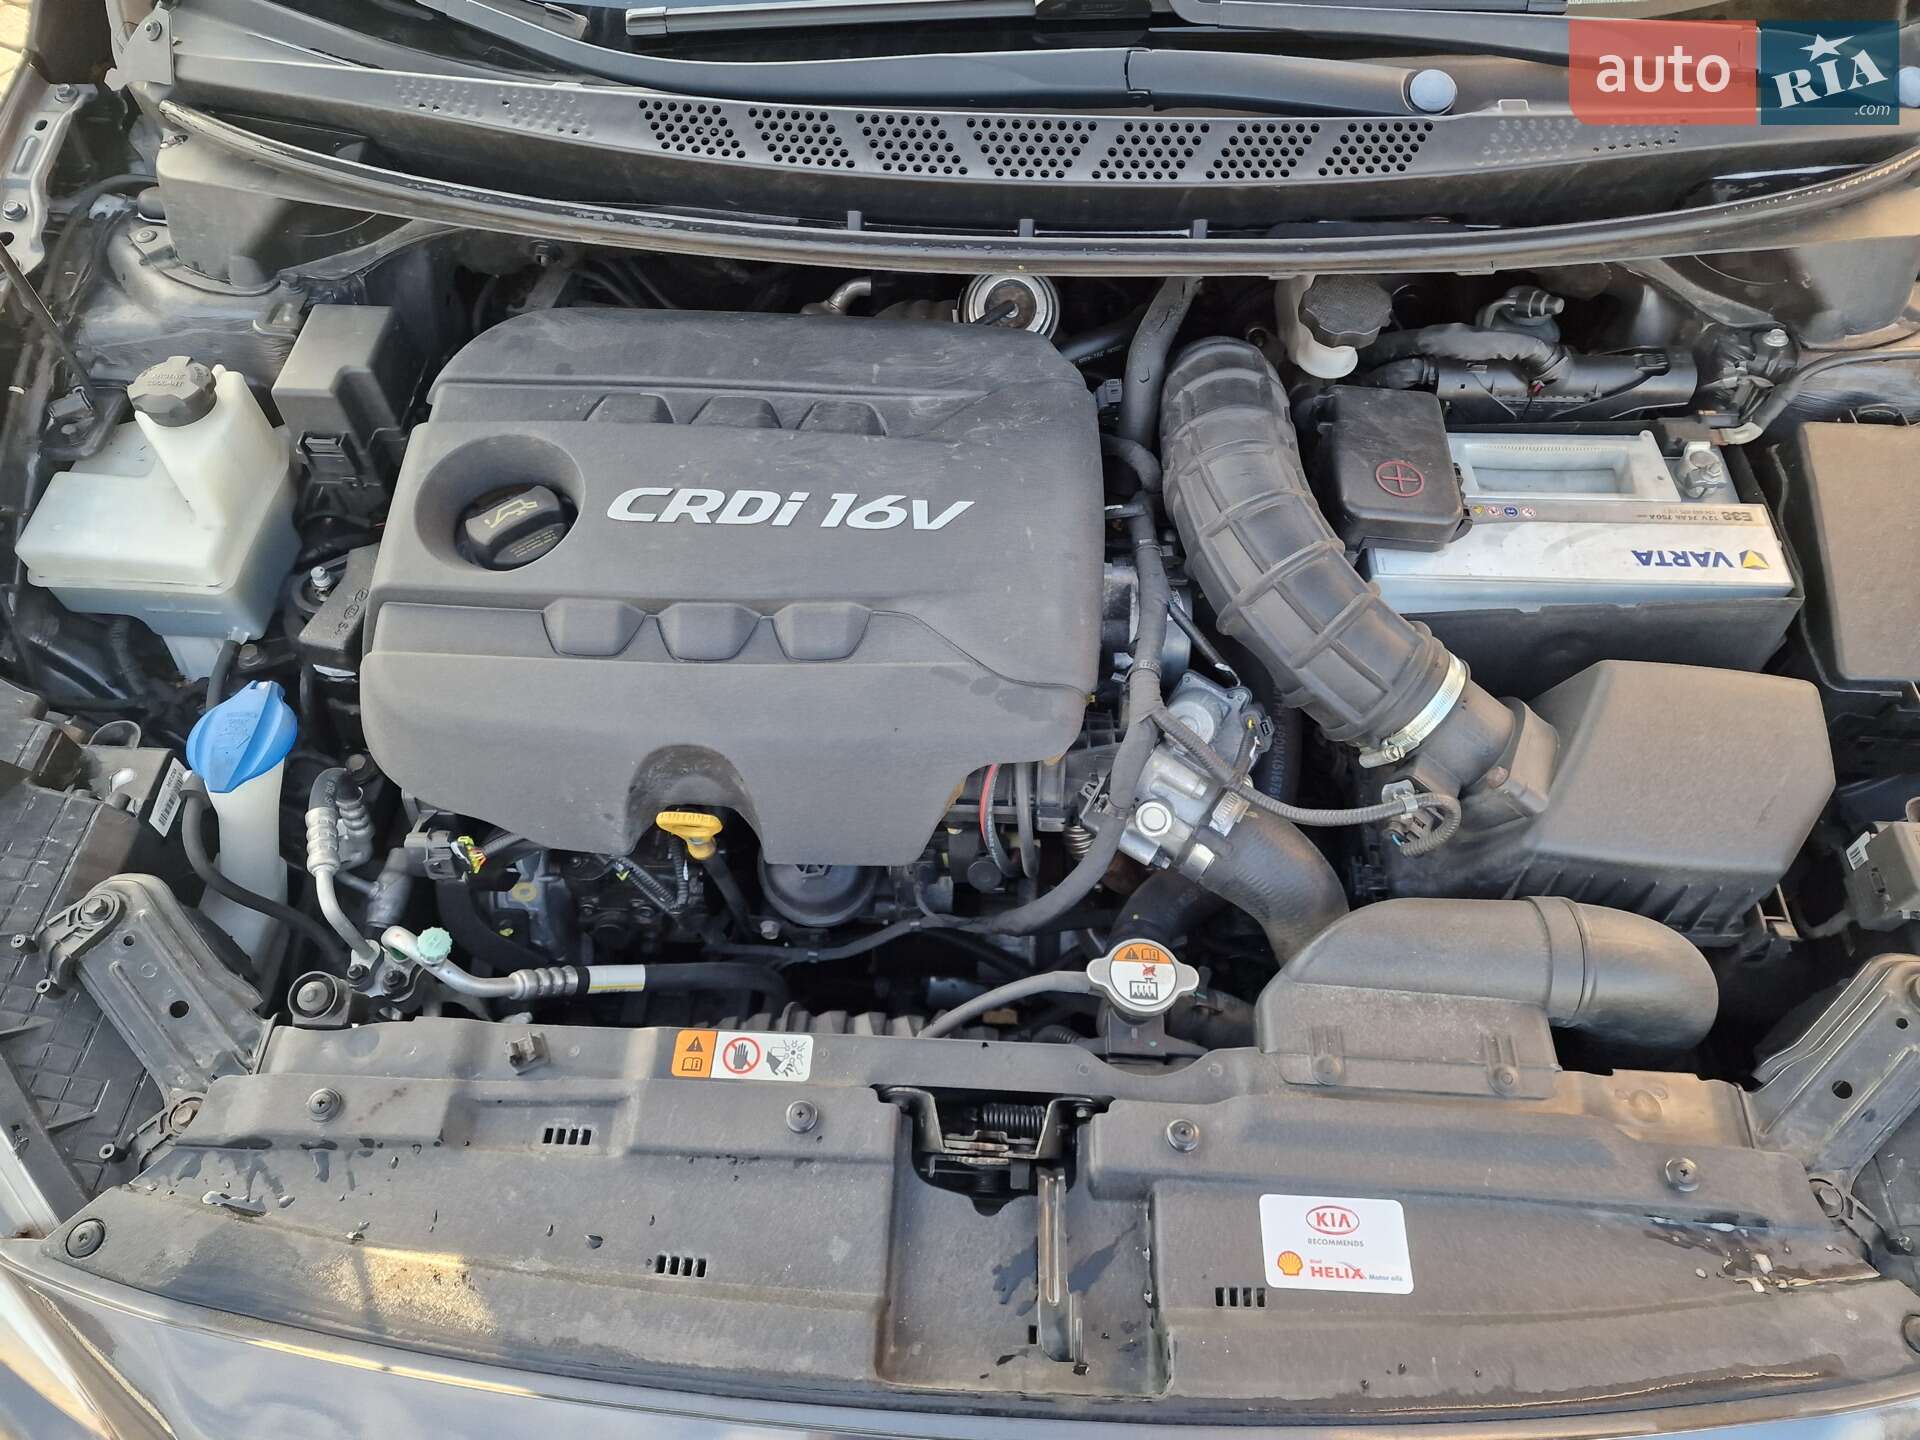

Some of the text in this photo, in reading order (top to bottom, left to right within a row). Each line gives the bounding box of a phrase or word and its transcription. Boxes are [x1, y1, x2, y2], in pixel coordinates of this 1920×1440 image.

[606, 487, 976, 531] CRDi 16V
[1631, 549, 1736, 568] VARTA
[1315, 1211, 1352, 1228] KIA
[1307, 1238, 1365, 1248] RECOMMENDS
[1310, 1265, 1364, 1280] HELIX
